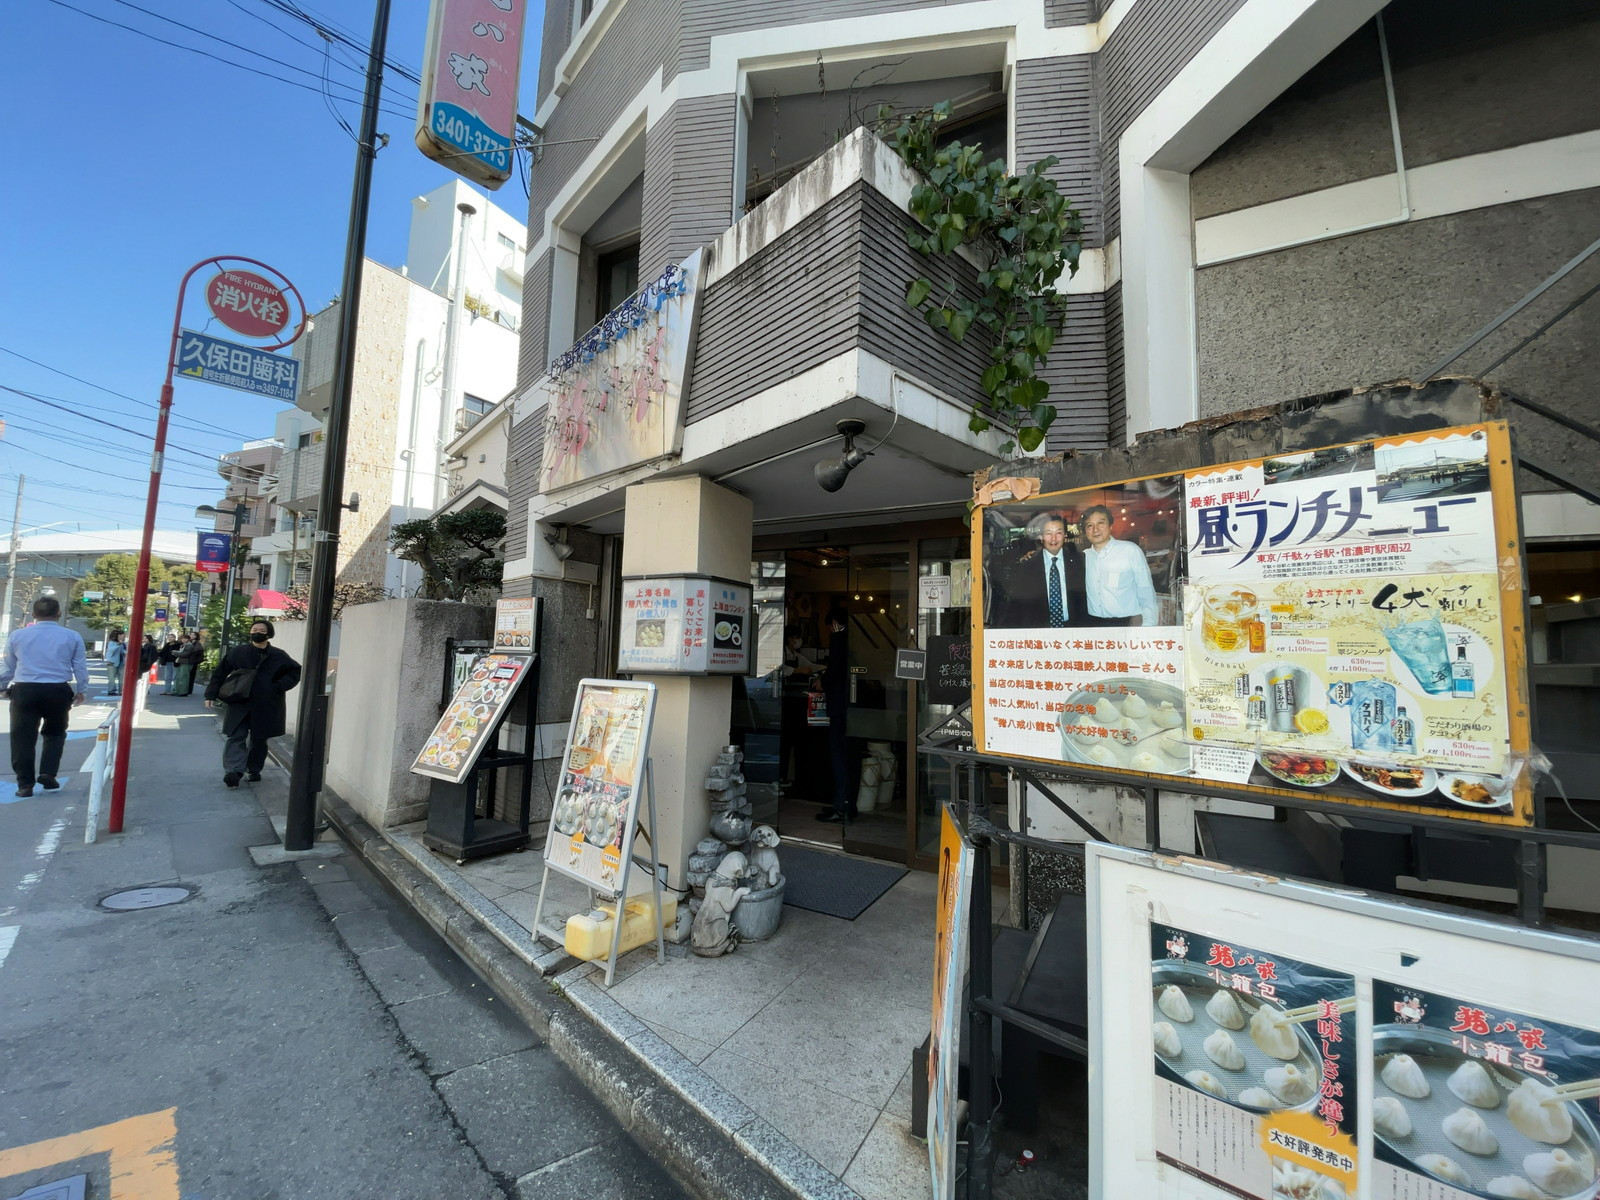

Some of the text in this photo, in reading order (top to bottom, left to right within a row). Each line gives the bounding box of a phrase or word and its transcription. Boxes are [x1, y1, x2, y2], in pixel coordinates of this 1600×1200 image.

[436, 109, 506, 167] 3401-3775
[214, 281, 284, 326] 消火栓
[225, 272, 279, 297] FIRE HYDRANT
[183, 337, 296, 388] 久保田歯科
[683, 597, 695, 657] 喜んでお帰り
[693, 589, 706, 648] 楽しくご来店
[988, 639, 1184, 652] この店は間違いなく本当においしいです。
[988, 659, 1177, 674] 度々来店したあの料理鉄人陳健一さんも
[988, 679, 1137, 696] 当店の料理を褒めてくれました。
[1206, 943, 1278, 980] 猪八戒
[1207, 968, 1280, 1002] 小籠包
[1450, 1005, 1548, 1051] 猪八戒
[1317, 998, 1344, 1139] 美味しさが違う
[1452, 1035, 1549, 1077] 小籠包
[1270, 1129, 1354, 1172] 大好評発売中
